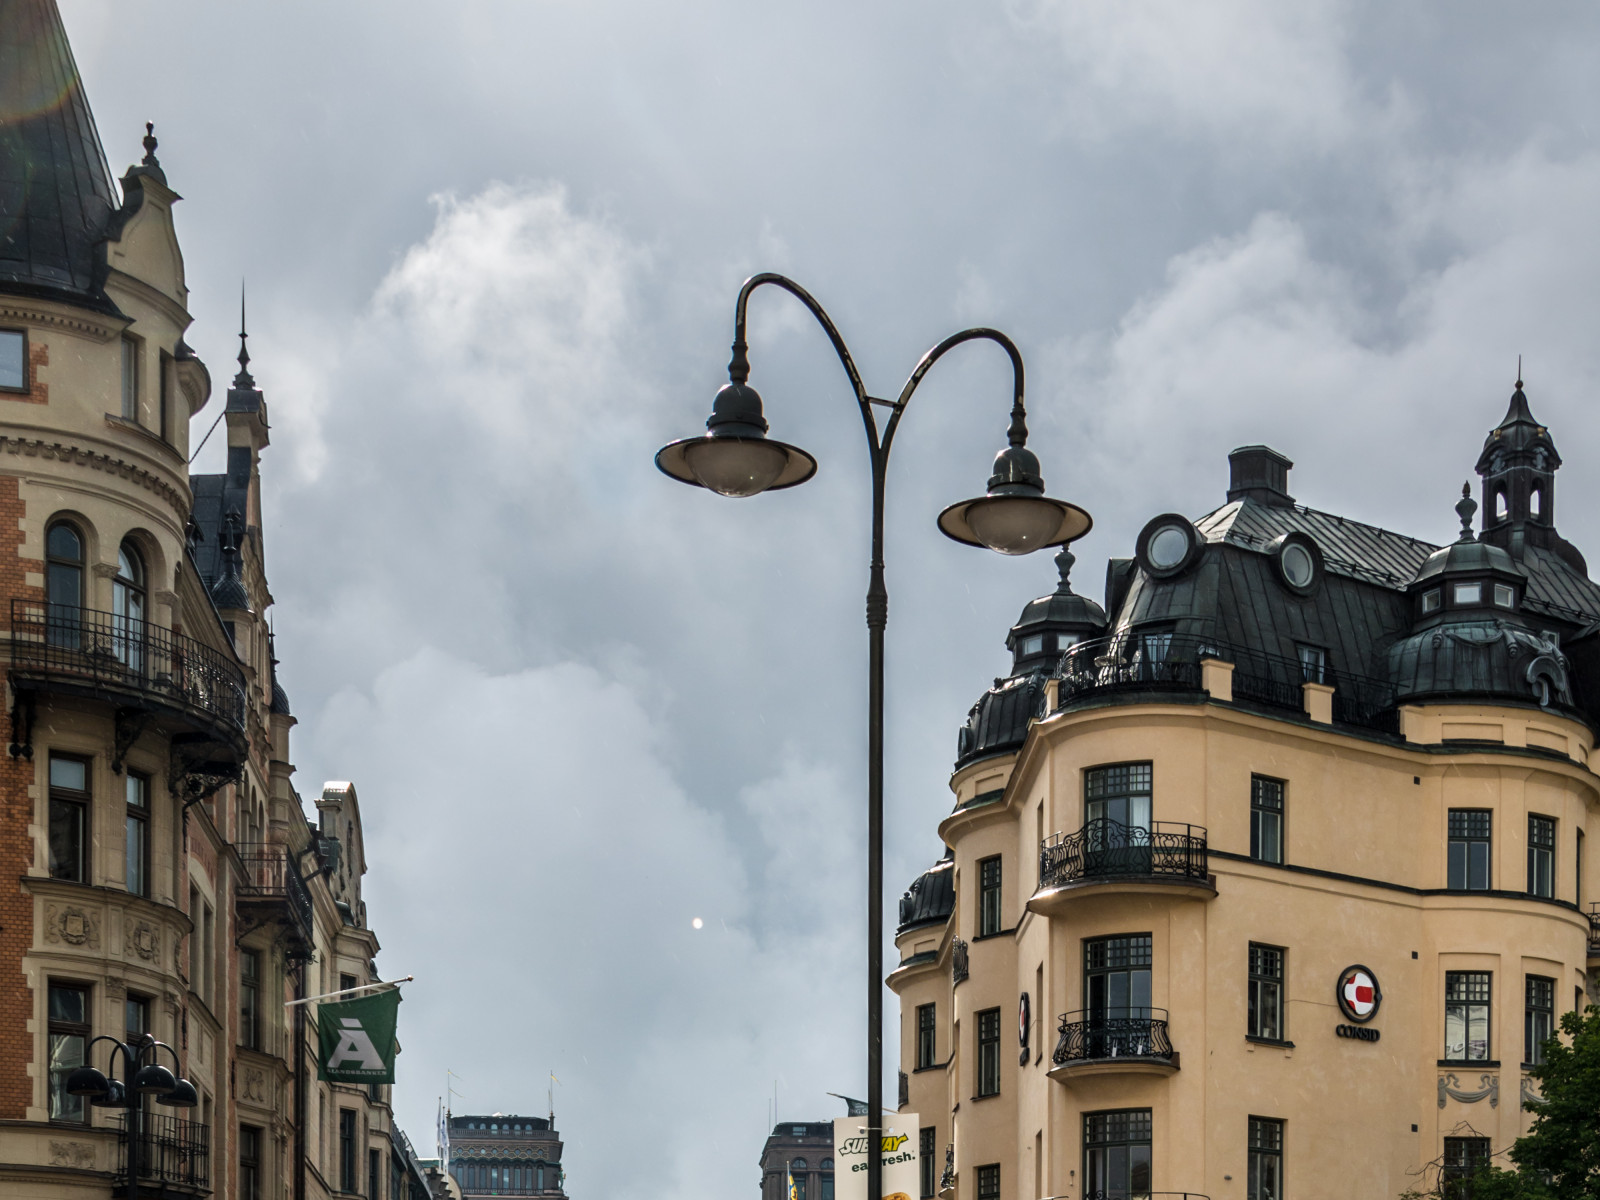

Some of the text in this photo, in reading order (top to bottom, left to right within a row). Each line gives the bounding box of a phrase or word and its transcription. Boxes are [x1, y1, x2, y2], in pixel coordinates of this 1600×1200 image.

[1336, 1024, 1380, 1042] CONSID
[839, 1133, 908, 1156] SUBAY
[852, 1152, 915, 1172] ea resh.
